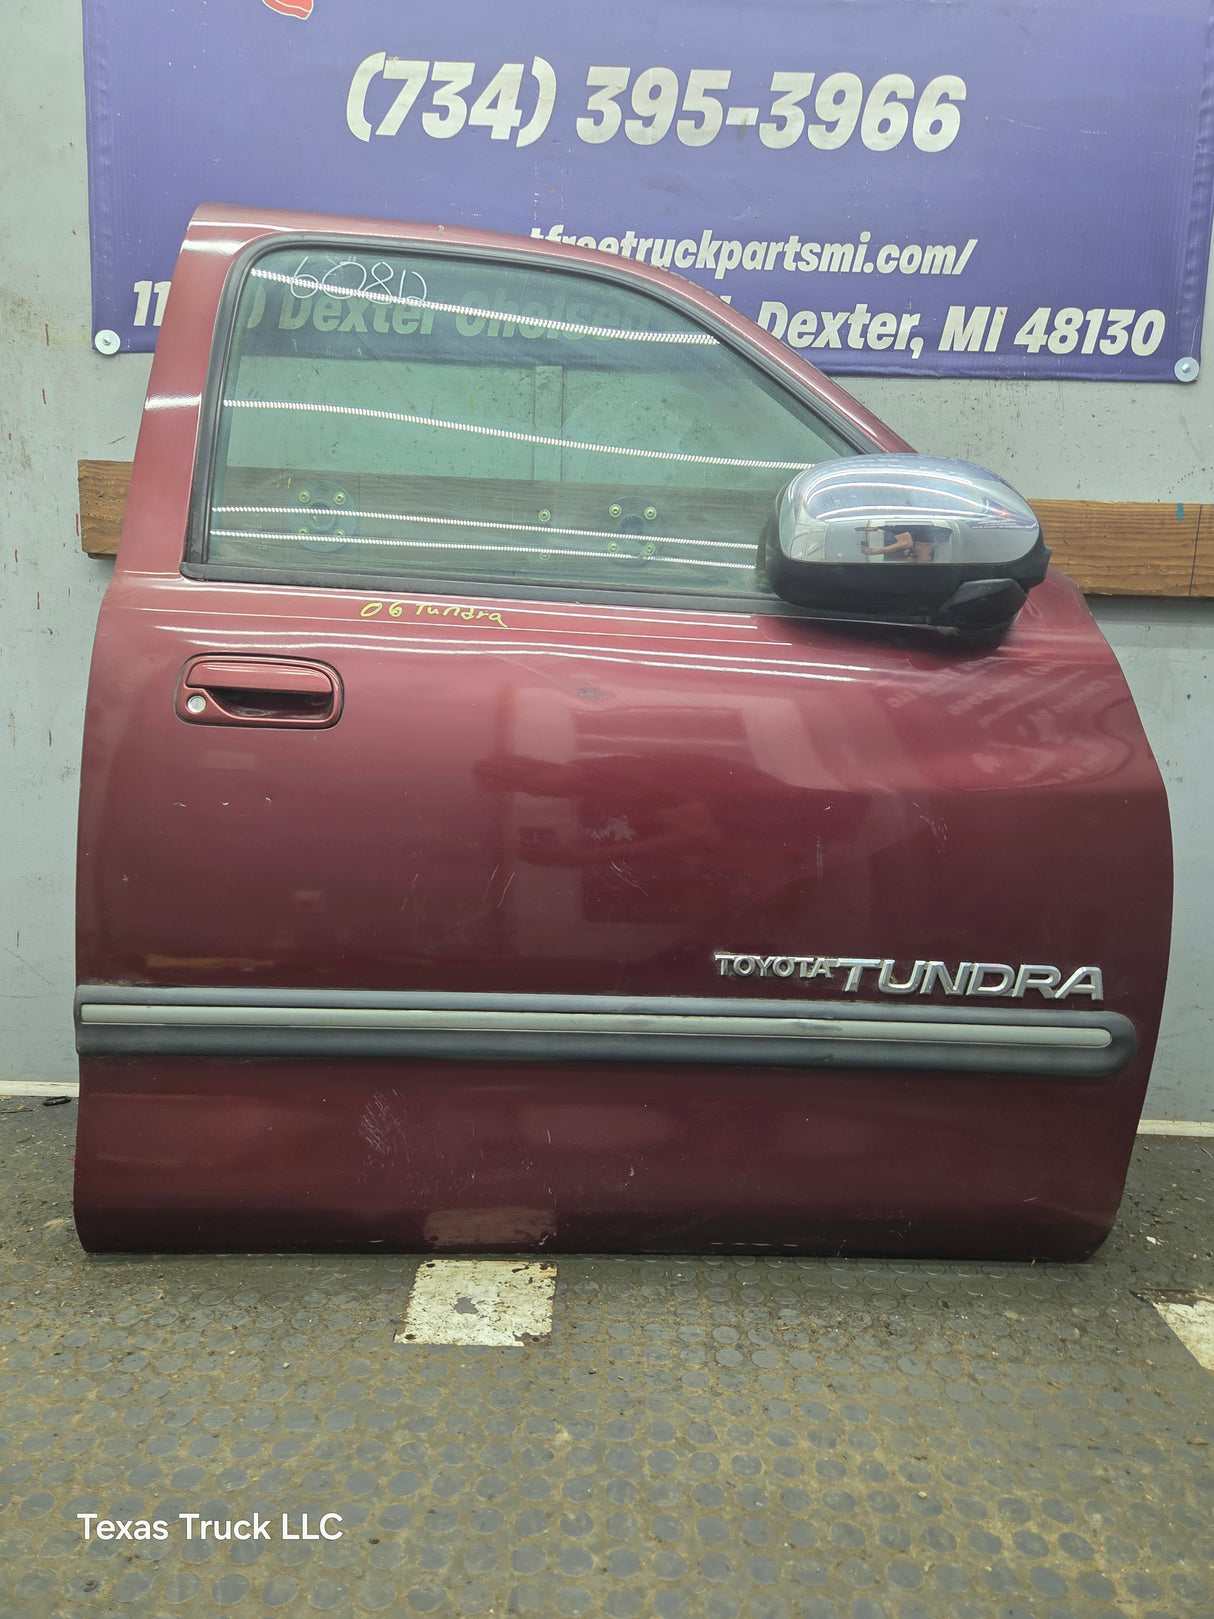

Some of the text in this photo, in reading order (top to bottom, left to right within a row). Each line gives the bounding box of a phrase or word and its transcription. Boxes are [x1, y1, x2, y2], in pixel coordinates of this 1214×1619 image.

[346, 51, 967, 152] (734) 395-3966
[278, 285, 437, 335] Dexter
[757, 301, 922, 359] Dexter,
[939, 305, 1007, 352] MI
[1014, 308, 1166, 356] 48130
[360, 601, 403, 618] 06
[714, 953, 1104, 1001] TOYOTA TUNDRA
